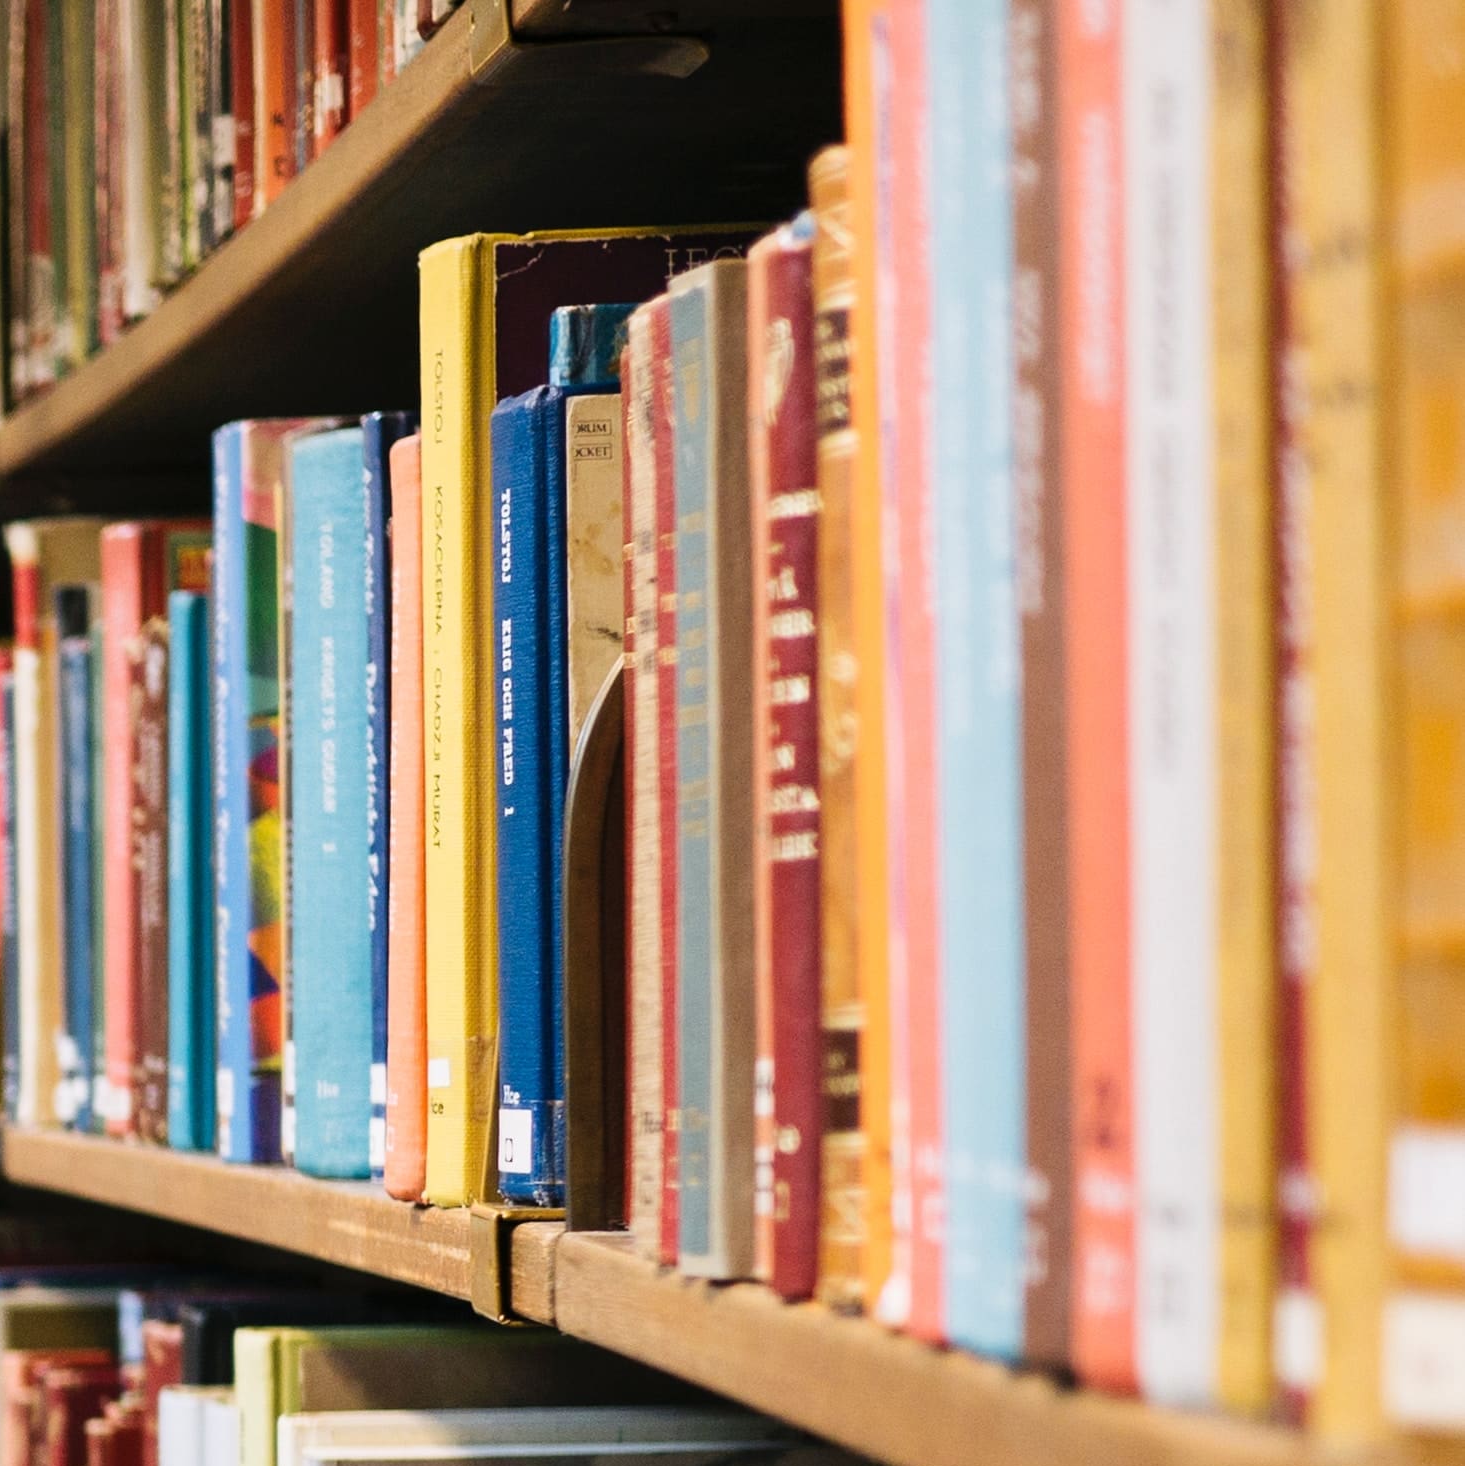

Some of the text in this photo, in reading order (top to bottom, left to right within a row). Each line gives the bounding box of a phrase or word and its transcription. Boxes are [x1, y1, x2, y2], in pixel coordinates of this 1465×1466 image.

[433, 348, 444, 445] TOLSTOJ
[433, 485, 444, 636] KOSACKERNA
[500, 488, 515, 818] TOLSTOJ KRIG OCH FRED 1
[432, 774, 442, 850] MURAT
